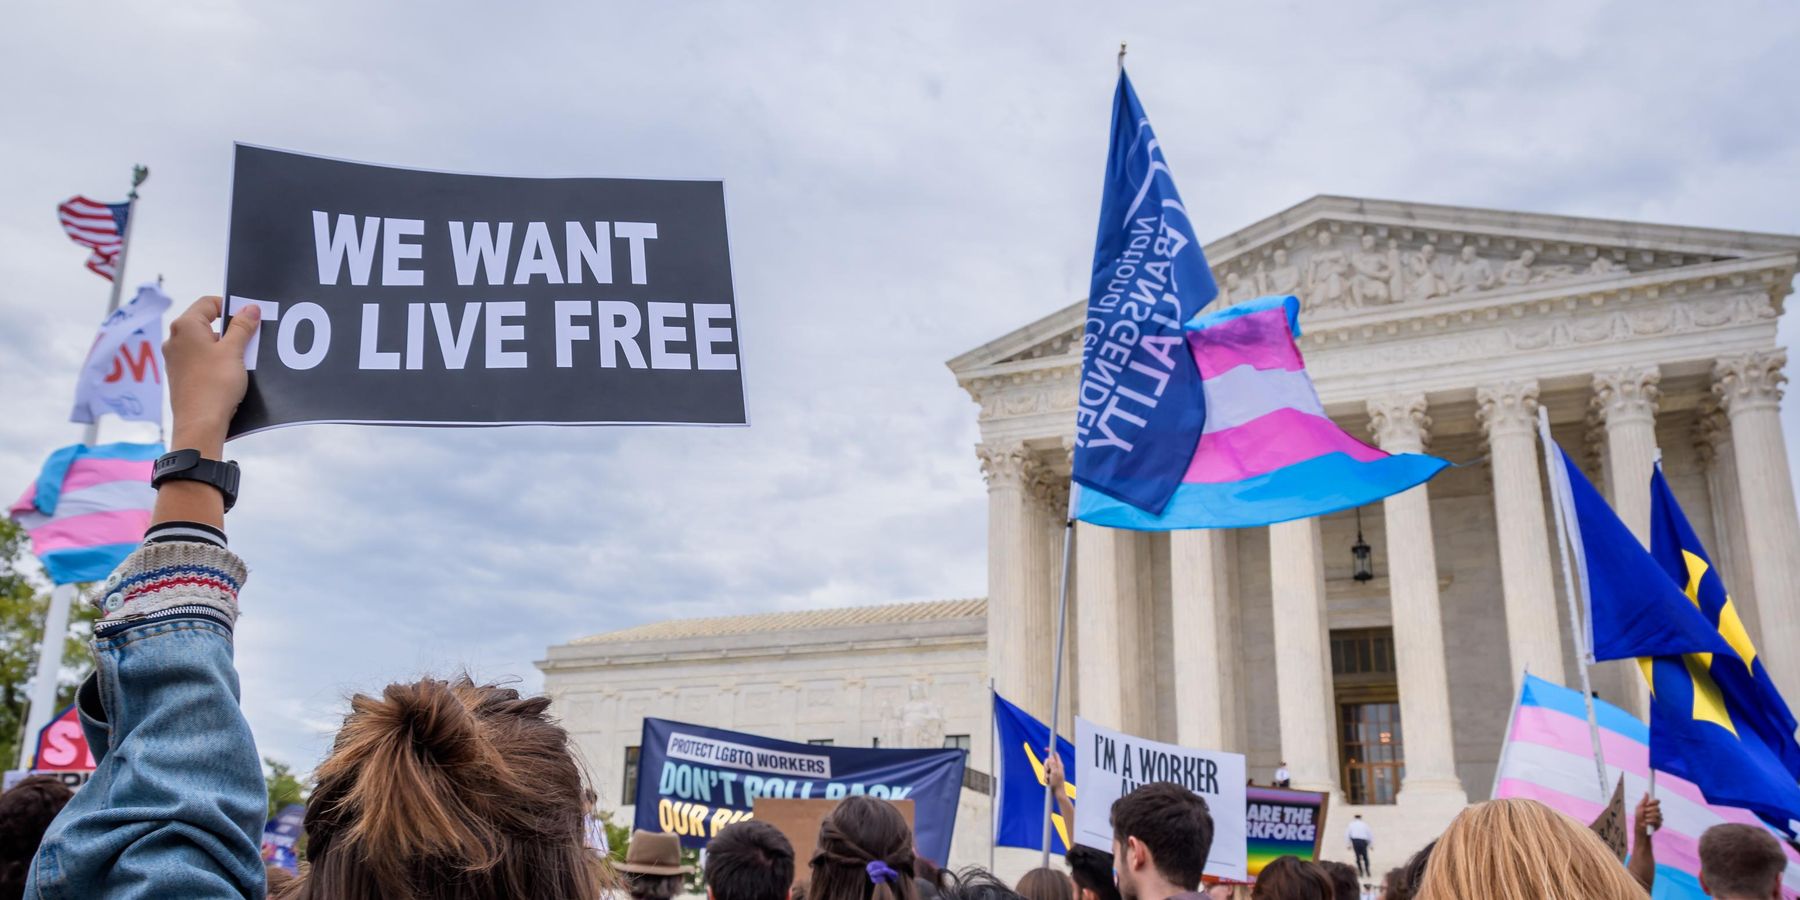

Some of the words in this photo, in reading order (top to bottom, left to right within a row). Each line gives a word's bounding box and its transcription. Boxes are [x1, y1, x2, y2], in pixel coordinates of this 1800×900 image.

[312, 210, 425, 287] WE
[448, 221, 658, 286] WANT
[229, 296, 332, 371] TO
[358, 301, 529, 371] LIVE
[554, 300, 738, 371] FREE
[672, 738, 716, 758] PROTECT
[715, 745, 754, 768] LGBTQ
[756, 755, 825, 774] WORKERS
[1095, 733, 1117, 775] I'M
[1122, 743, 1133, 779] A
[1139, 747, 1219, 795] WORKER
[659, 761, 738, 806] DON'T
[658, 799, 709, 838] OUR
[1247, 804, 1283, 822] ARE
[1283, 806, 1314, 825] THE
